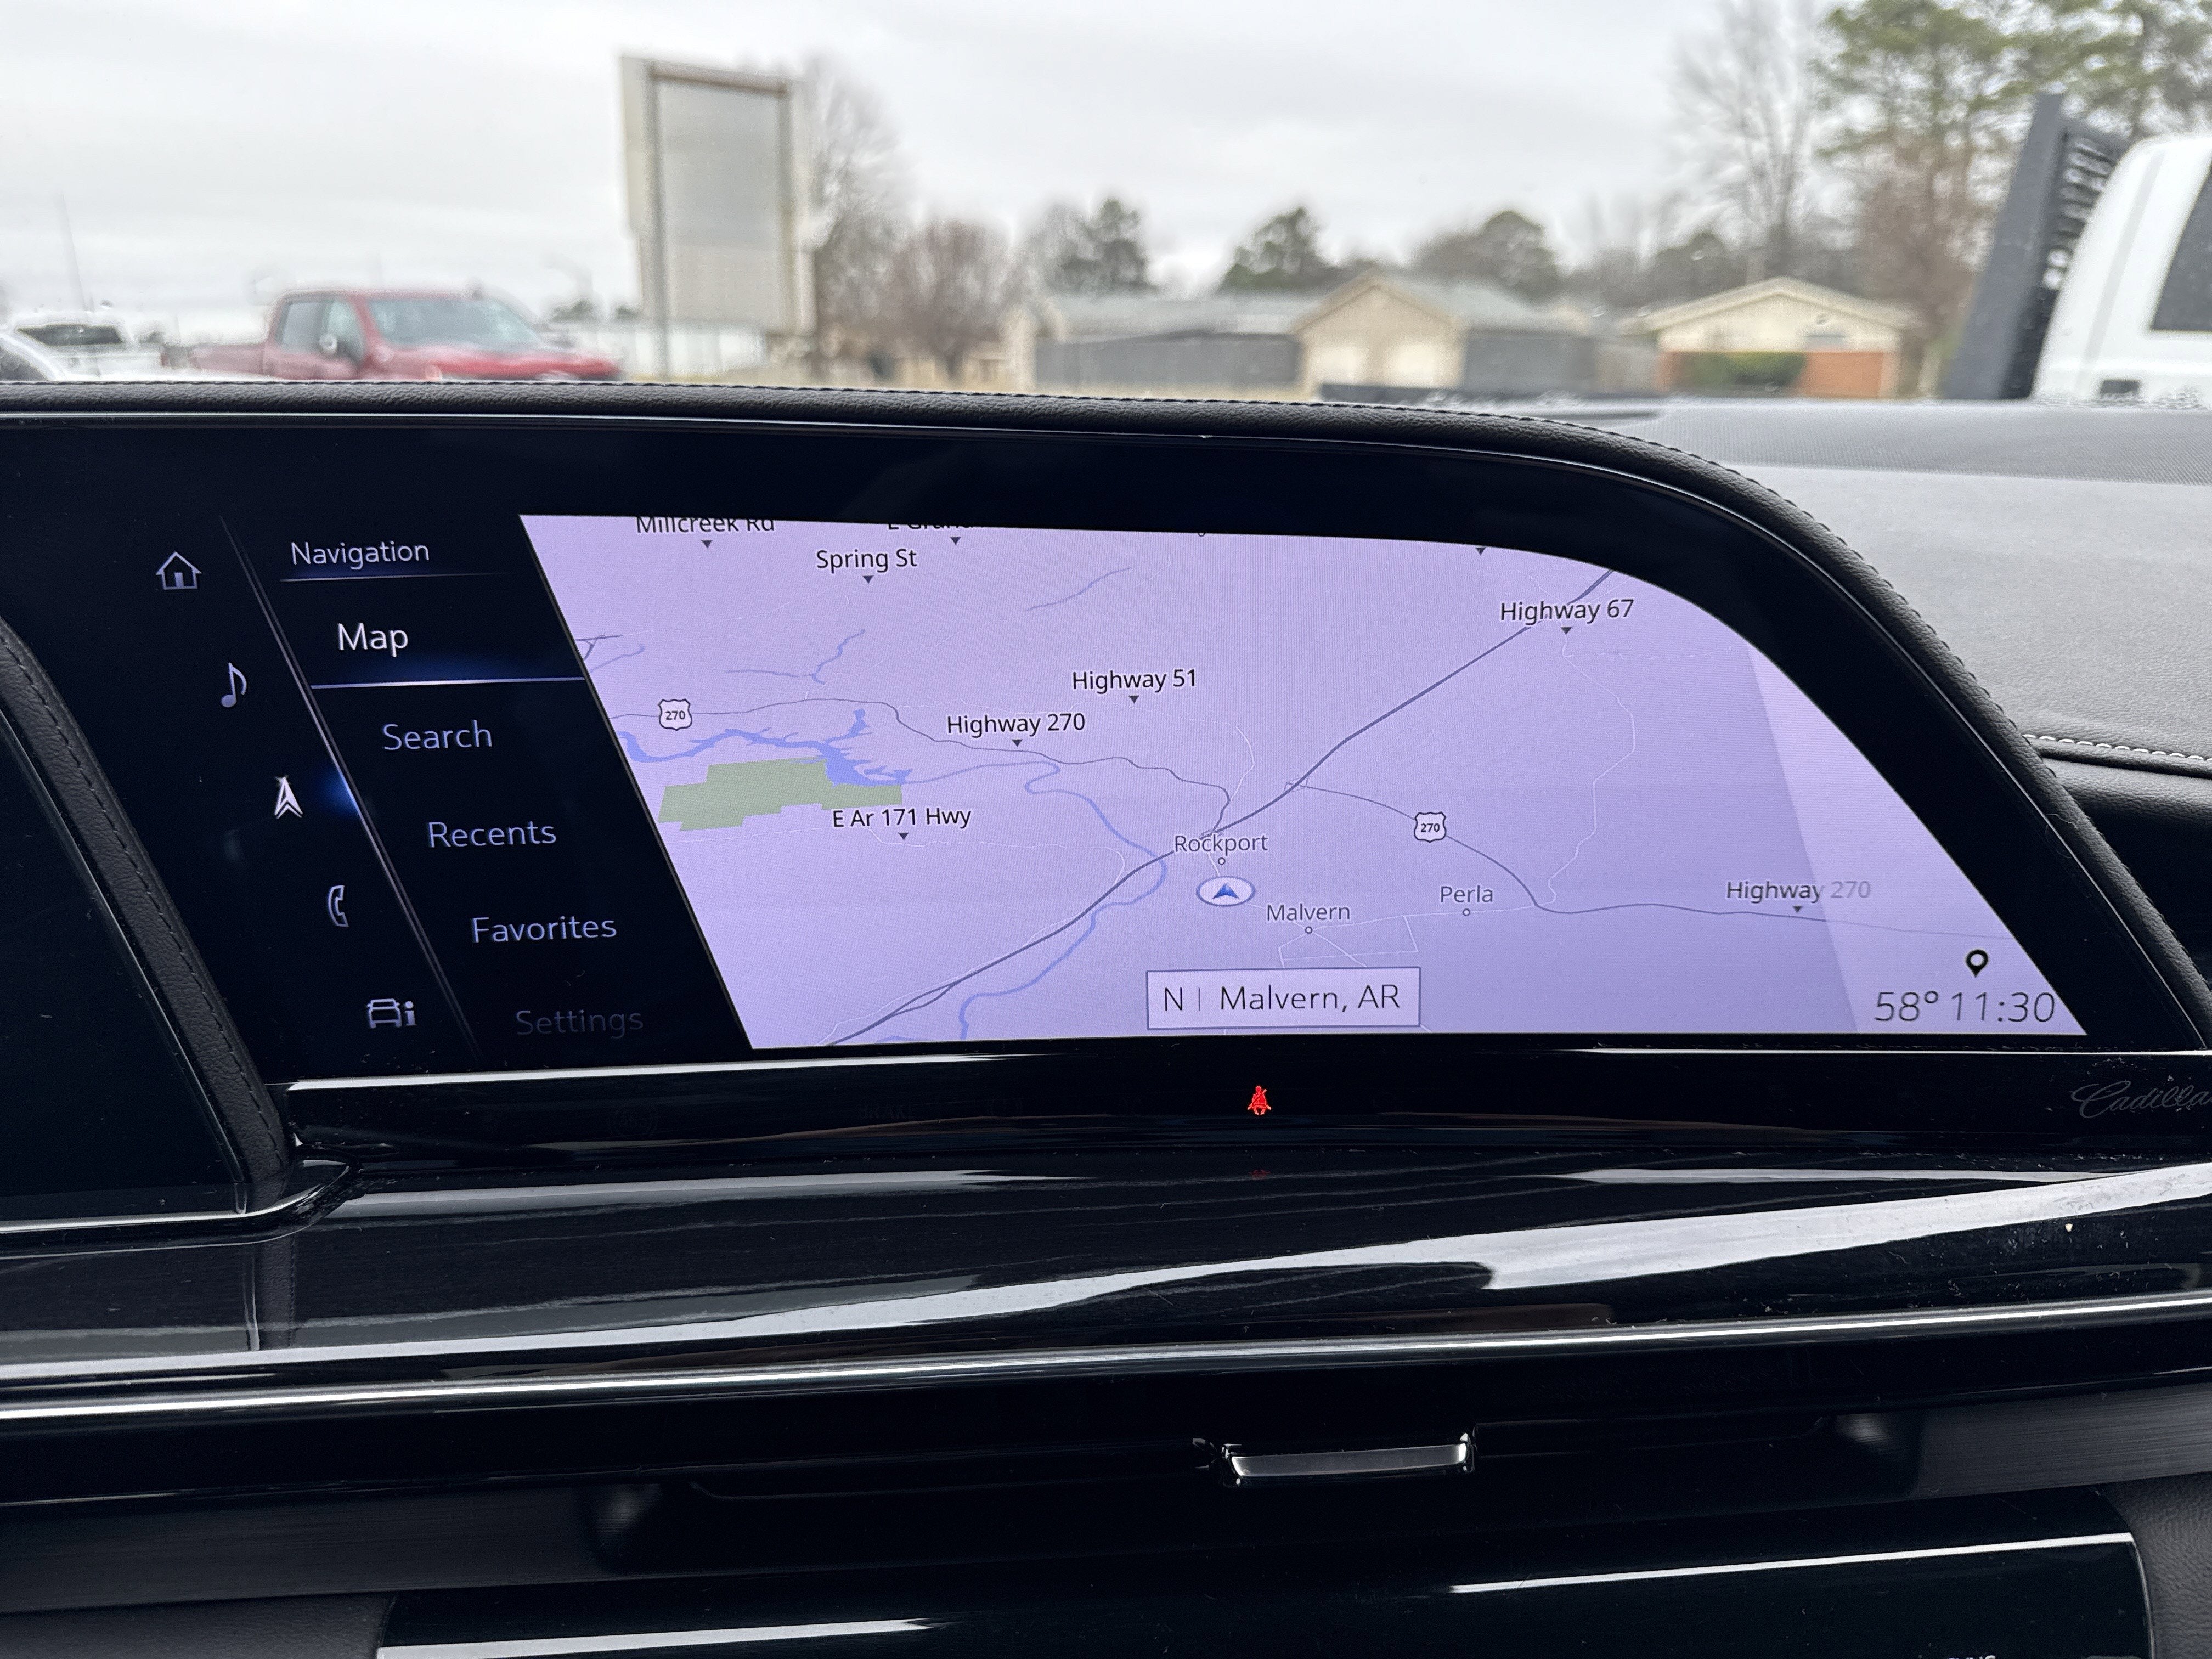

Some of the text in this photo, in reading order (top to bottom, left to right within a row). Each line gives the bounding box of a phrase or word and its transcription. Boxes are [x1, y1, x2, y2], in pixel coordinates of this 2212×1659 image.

[636, 516, 740, 533] Millcreek
[291, 540, 431, 571] Navigation
[816, 548, 918, 574] Spring St
[1501, 599, 1635, 626] Highway 67
[338, 622, 409, 658] Map
[1073, 669, 1197, 695] Highway 51
[665, 710, 687, 721] 270
[947, 713, 1086, 739] Highway 270
[382, 719, 493, 752] Search
[833, 808, 973, 830] E Ar 171 Hwy
[1420, 822, 1441, 834] 270
[428, 821, 558, 849] Recents
[1175, 834, 1269, 857] Rockport
[1441, 885, 1494, 904] Perla
[1727, 880, 1871, 905] Highway 270
[1267, 903, 1351, 922] Malvern
[472, 916, 618, 945] Favorites
[1164, 984, 1401, 1014] N Malvern, AR
[1874, 990, 2056, 1023] 58° 11:30
[515, 1009, 645, 1040] Settings
[2071, 1080, 2212, 1118] Cadilla
